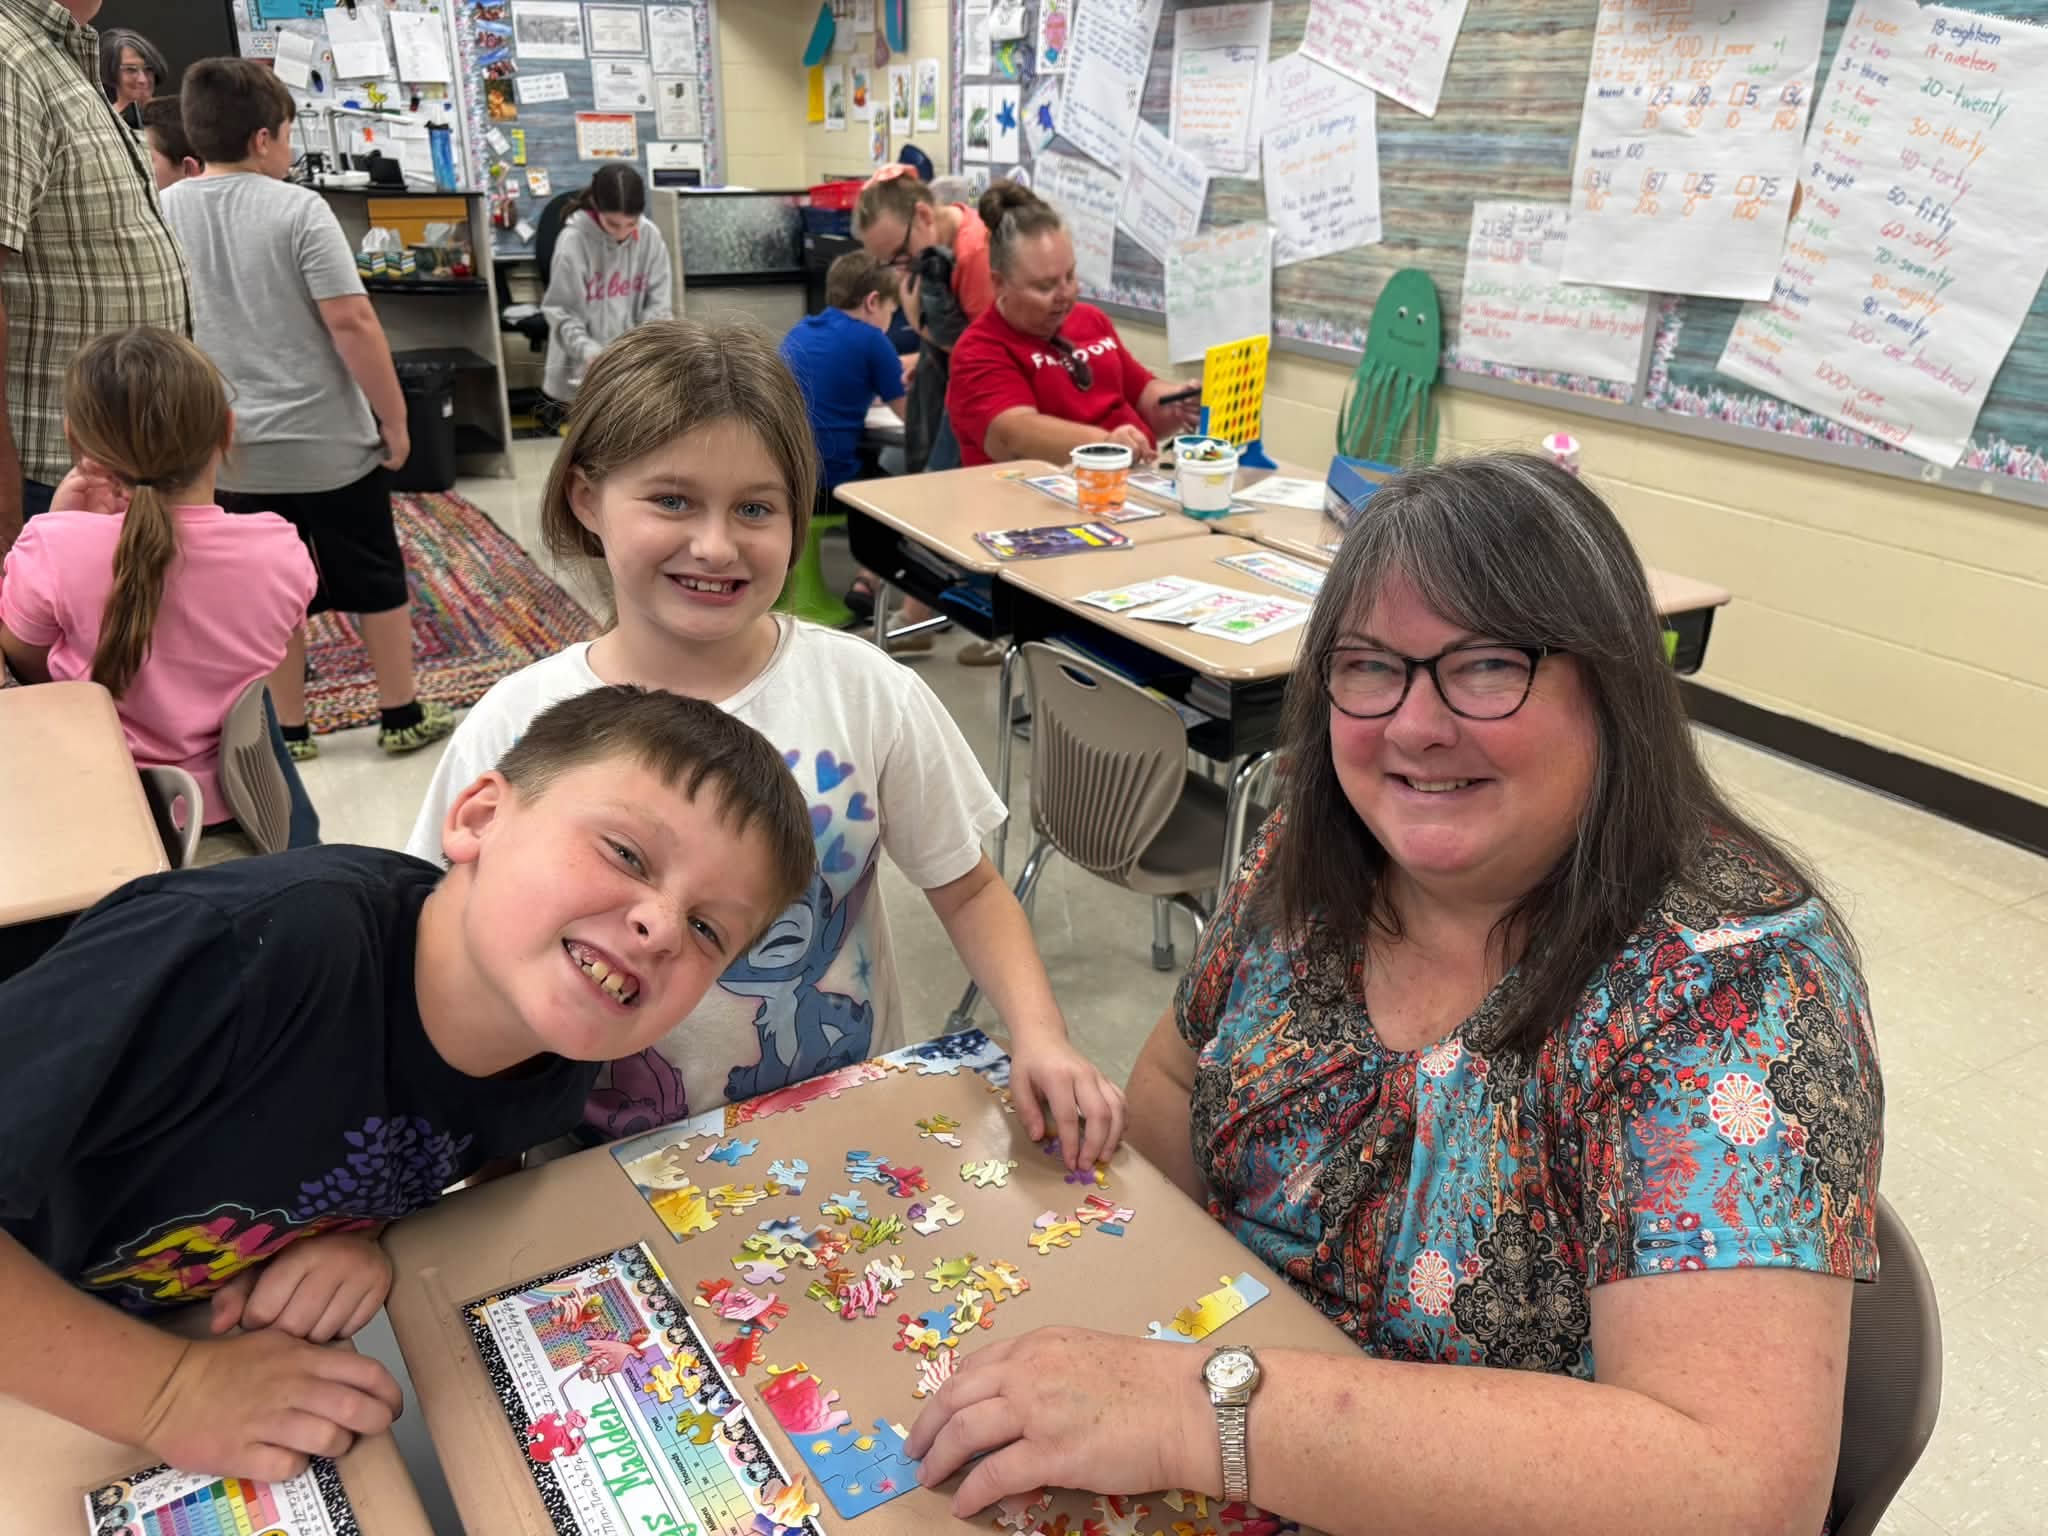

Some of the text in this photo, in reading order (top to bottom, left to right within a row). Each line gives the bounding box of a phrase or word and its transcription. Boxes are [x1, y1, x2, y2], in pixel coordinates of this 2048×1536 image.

[625, 1368, 641, 1392] Decimals
[651, 1416, 663, 1431] Ones
[590, 1398, 656, 1497] Madden
[671, 1453, 692, 1485] Thousands
[701, 1507, 718, 1532] Millions
